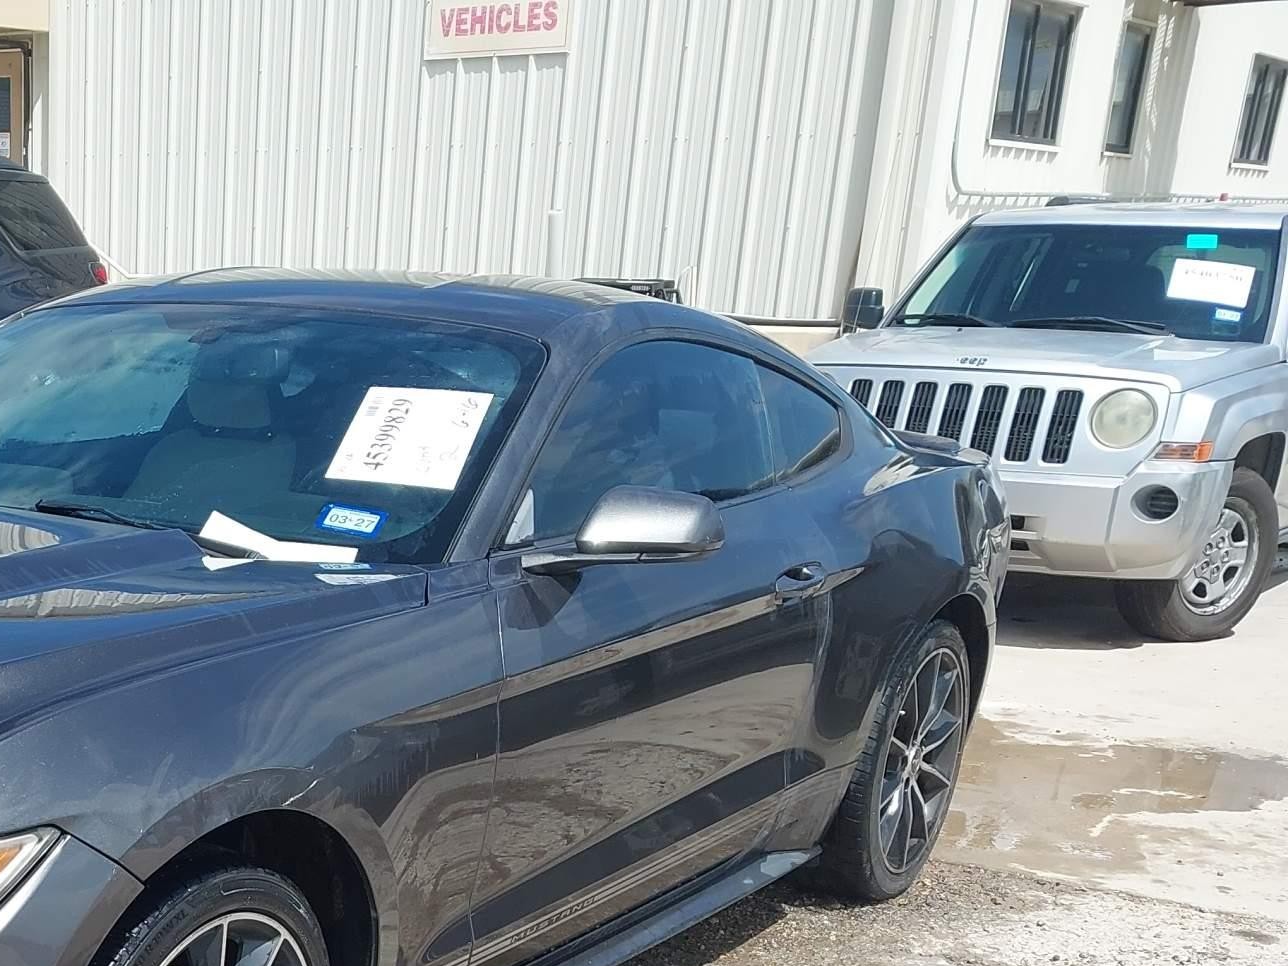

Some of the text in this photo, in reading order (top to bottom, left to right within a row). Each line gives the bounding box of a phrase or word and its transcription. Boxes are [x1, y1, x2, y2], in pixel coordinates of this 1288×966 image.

[440, 1, 559, 37] VEHICLES
[955, 356, 988, 367] eep
[363, 398, 412, 470] 45399829
[511, 896, 595, 943] MUSTANG
